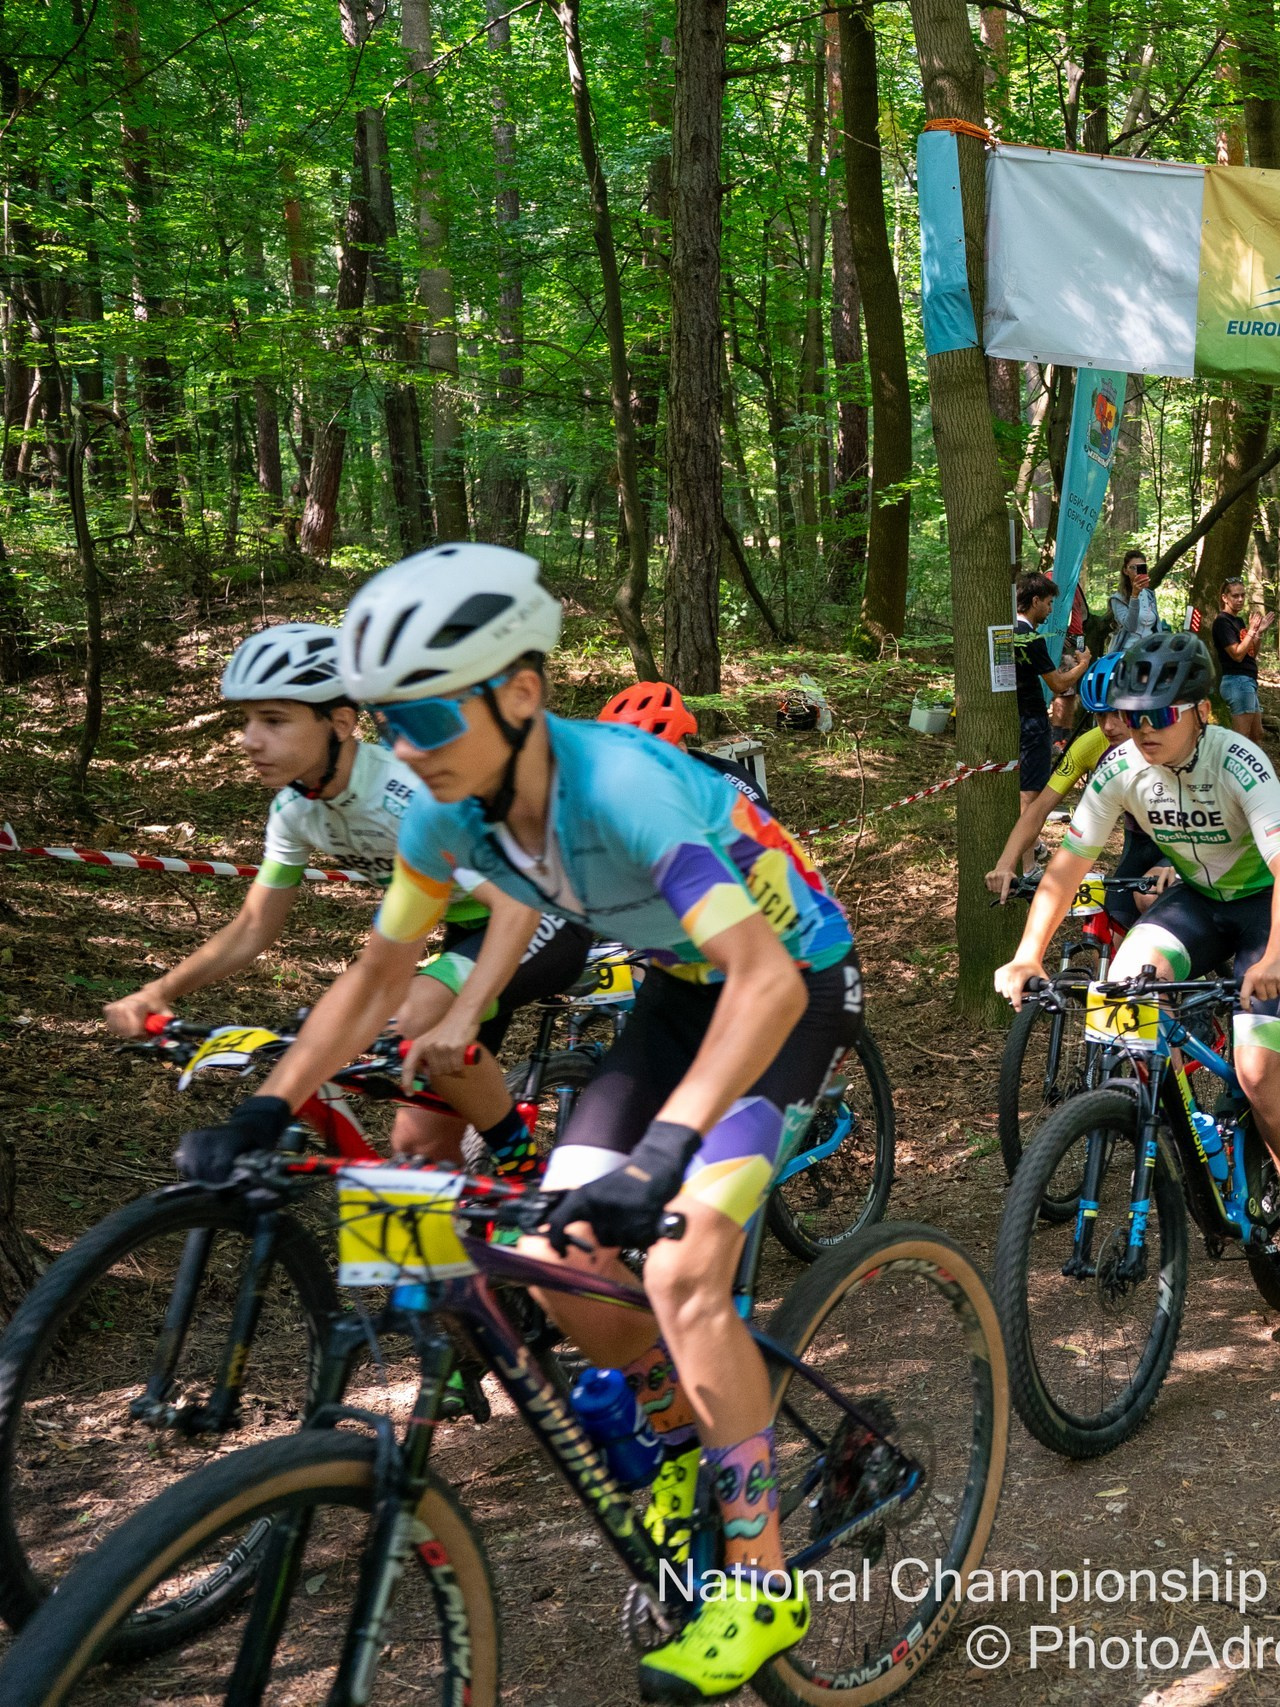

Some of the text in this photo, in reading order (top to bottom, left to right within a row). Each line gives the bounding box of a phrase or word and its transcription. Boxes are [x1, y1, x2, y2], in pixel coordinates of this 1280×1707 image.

[1096, 763, 1121, 786] MTB
[1226, 758, 1255, 787] ROAD
[1227, 743, 1272, 784] BEROE
[1147, 810, 1224, 828] BEROE
[1156, 830, 1227, 844] cycling club
[1104, 1000, 1140, 1033] 73
